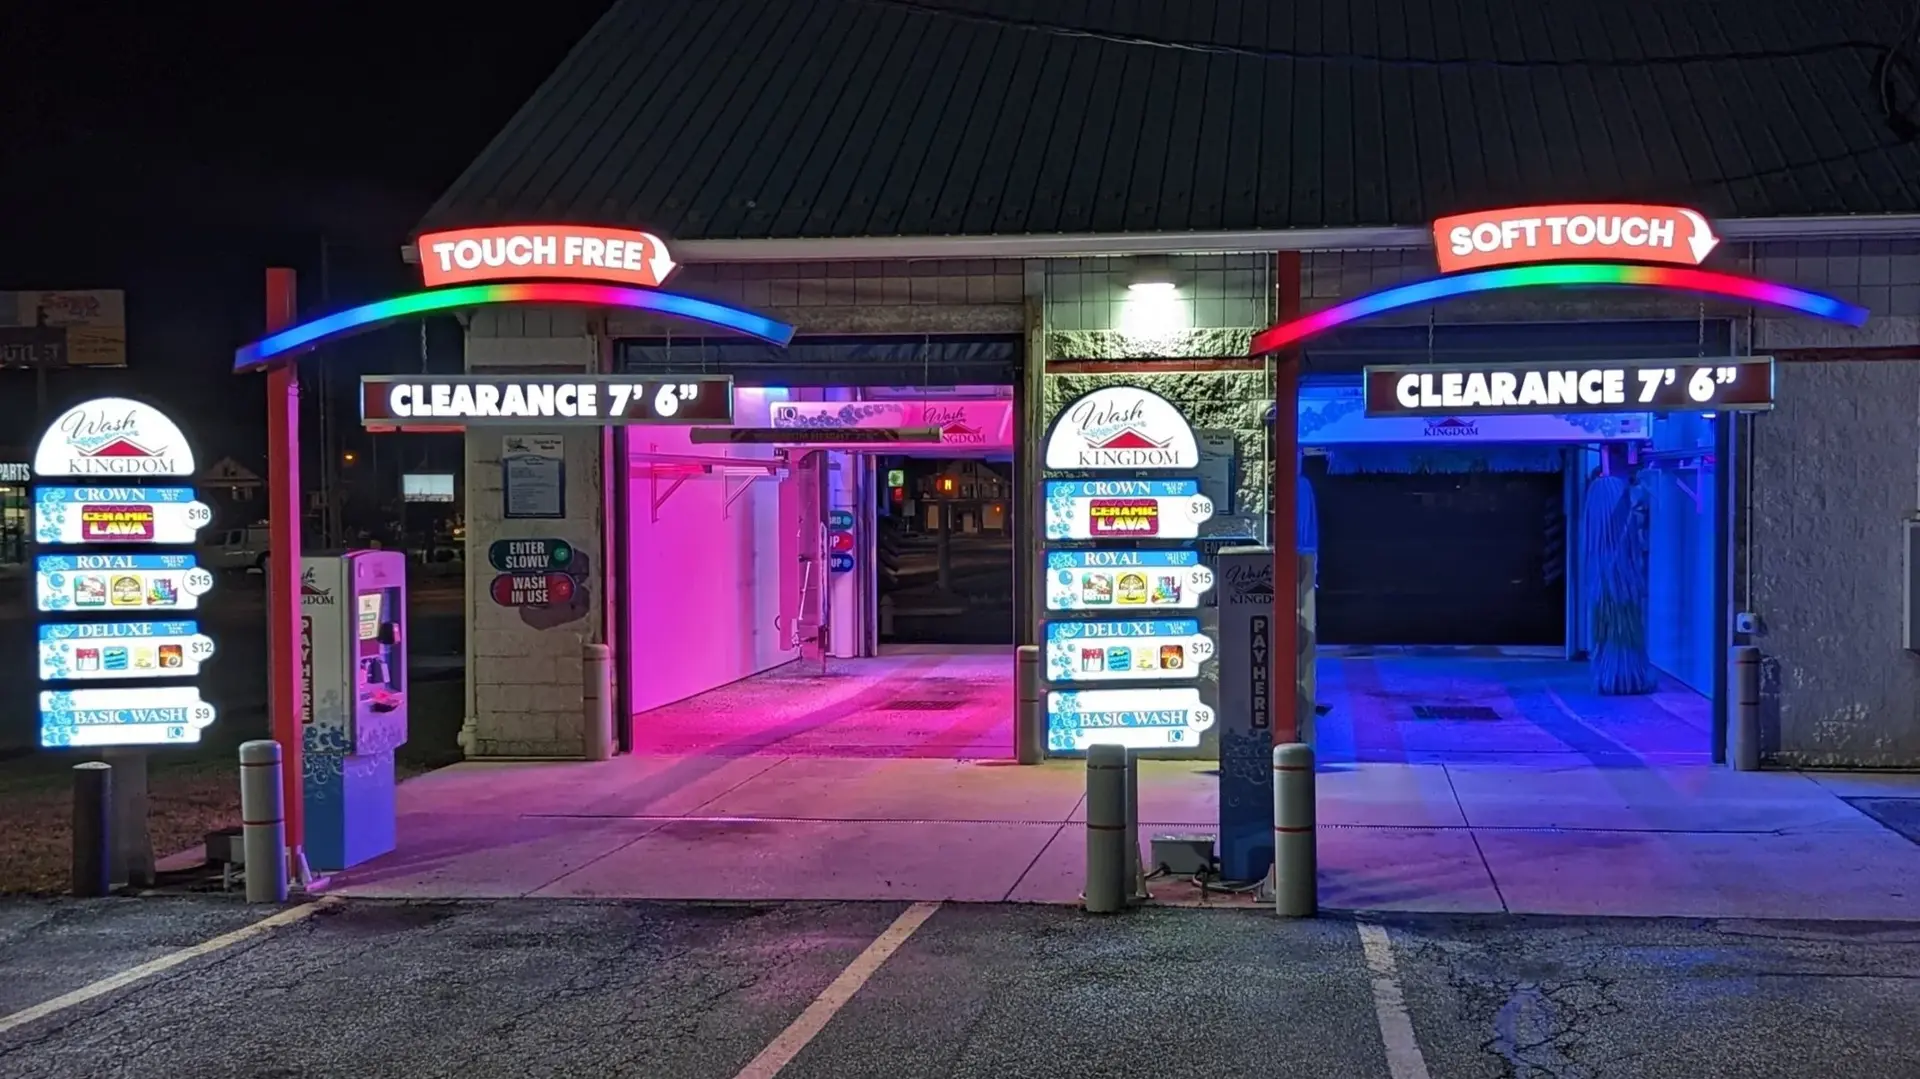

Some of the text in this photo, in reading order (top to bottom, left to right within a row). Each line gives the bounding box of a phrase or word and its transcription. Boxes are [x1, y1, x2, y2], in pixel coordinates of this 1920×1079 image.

[1449, 216, 1674, 256] SOFT TOUCH
[432, 236, 644, 271] TOUCH FREE
[1396, 370, 1625, 408] CLEARANCE
[390, 383, 597, 417] CLEARANCE
[925, 407, 967, 423] Wash
[1071, 398, 1145, 430] Wash
[60, 409, 137, 439] Wash
[1423, 428, 1479, 436] KINGDOM
[1078, 450, 1179, 466] KINGDOM
[69, 458, 175, 473] KINGDOM
[73, 487, 146, 501] CROWN
[1083, 482, 1151, 495] CROWN
[188, 508, 209, 520] $18
[1090, 506, 1158, 517] CERAMIC
[1191, 502, 1211, 514] $18
[82, 512, 153, 522] CERAMIC
[1097, 516, 1151, 531] LAVA
[89, 521, 146, 535] LAVA
[510, 541, 545, 555] ENTER
[76, 555, 137, 568] ROYAL
[505, 555, 550, 568] SLOWLY
[1083, 552, 1142, 565] ROYAL
[189, 574, 211, 586] $15
[512, 577, 546, 590] WASH
[1191, 572, 1211, 584] $15
[511, 590, 549, 603] IN USE
[78, 623, 153, 637] DELUXE
[1083, 621, 1155, 636] DELUXE
[191, 641, 212, 653] $12
[1192, 641, 1212, 654] $12
[74, 707, 183, 724] BASIC WASH
[195, 707, 210, 719] $9
[1079, 710, 1184, 726] BASIC WASH
[1194, 710, 1209, 722] $9
